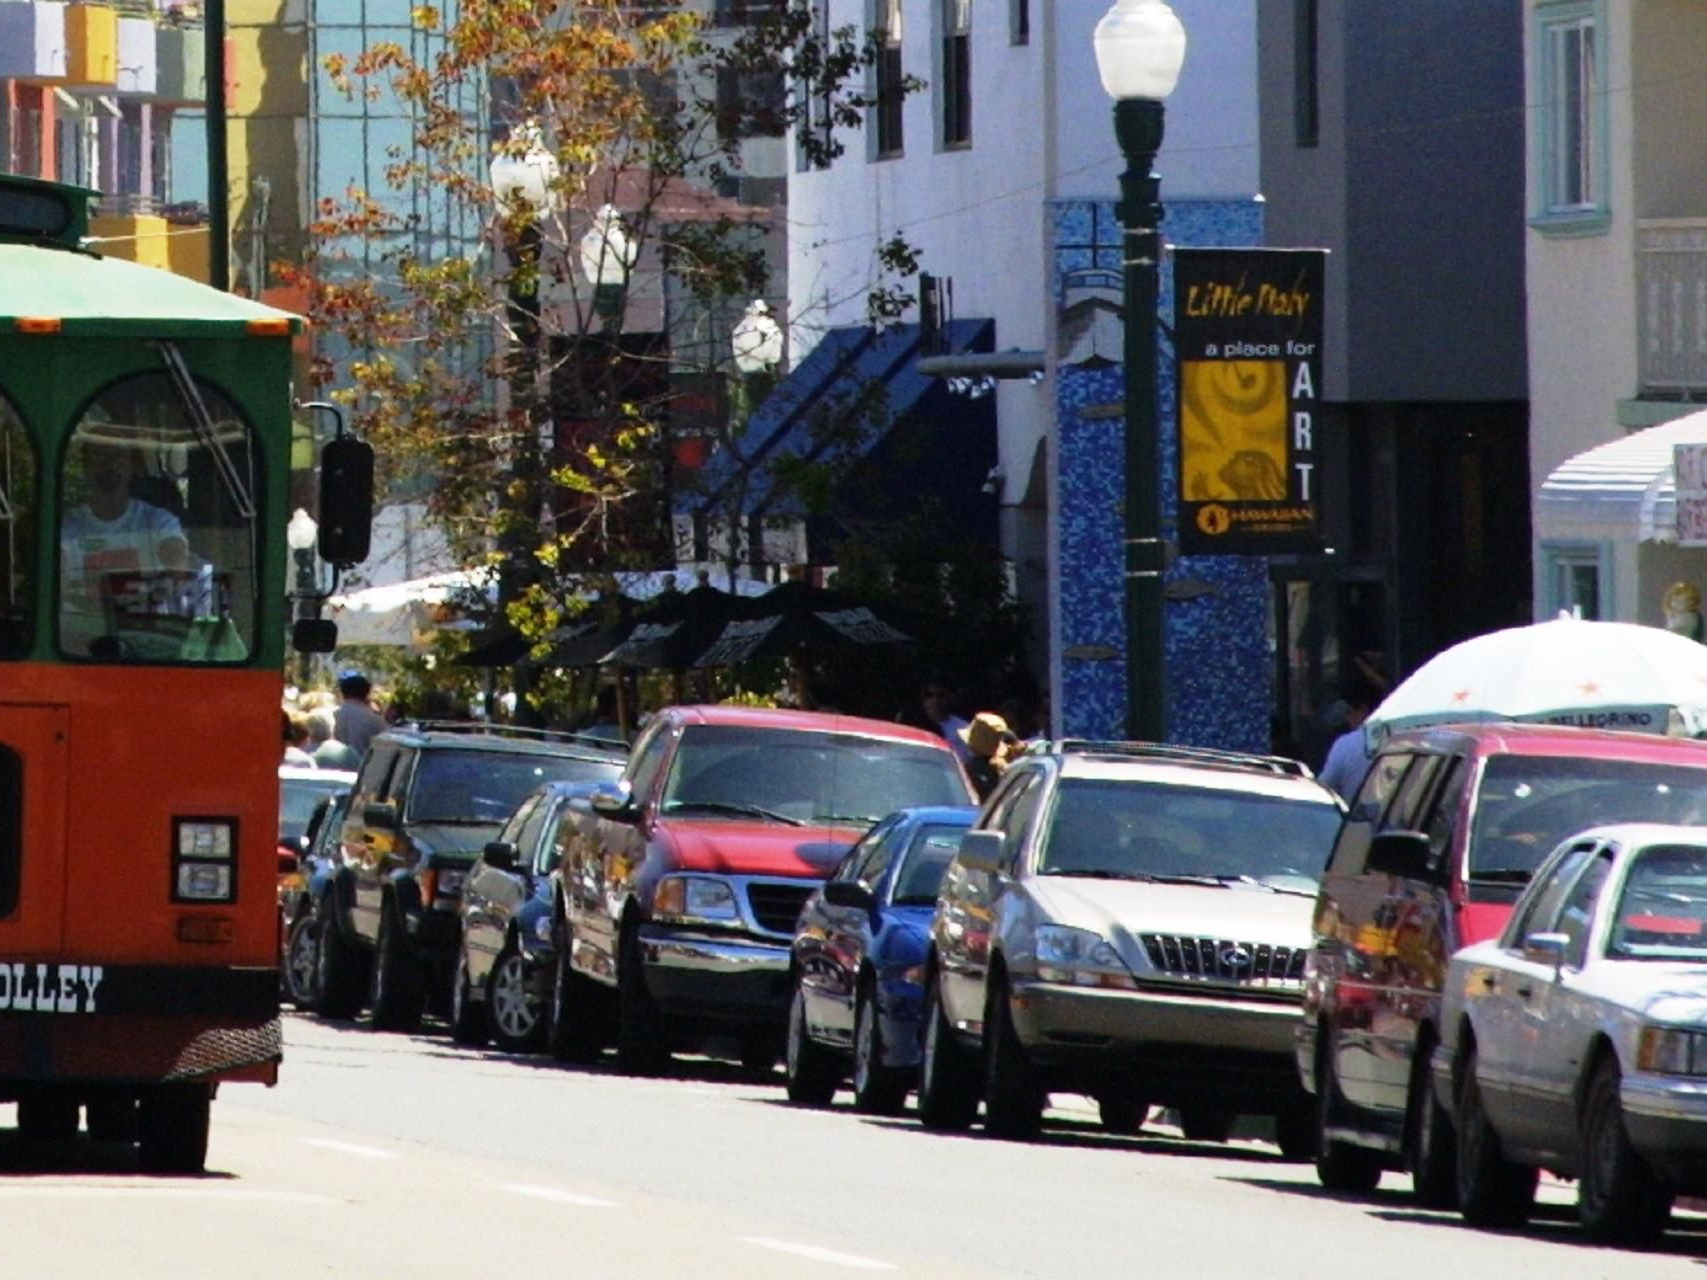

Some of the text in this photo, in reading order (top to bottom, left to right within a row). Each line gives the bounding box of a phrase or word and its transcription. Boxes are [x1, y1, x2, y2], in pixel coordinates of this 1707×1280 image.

[1186, 271, 1310, 326] Little Italy
[1205, 339, 1316, 359] a place for
